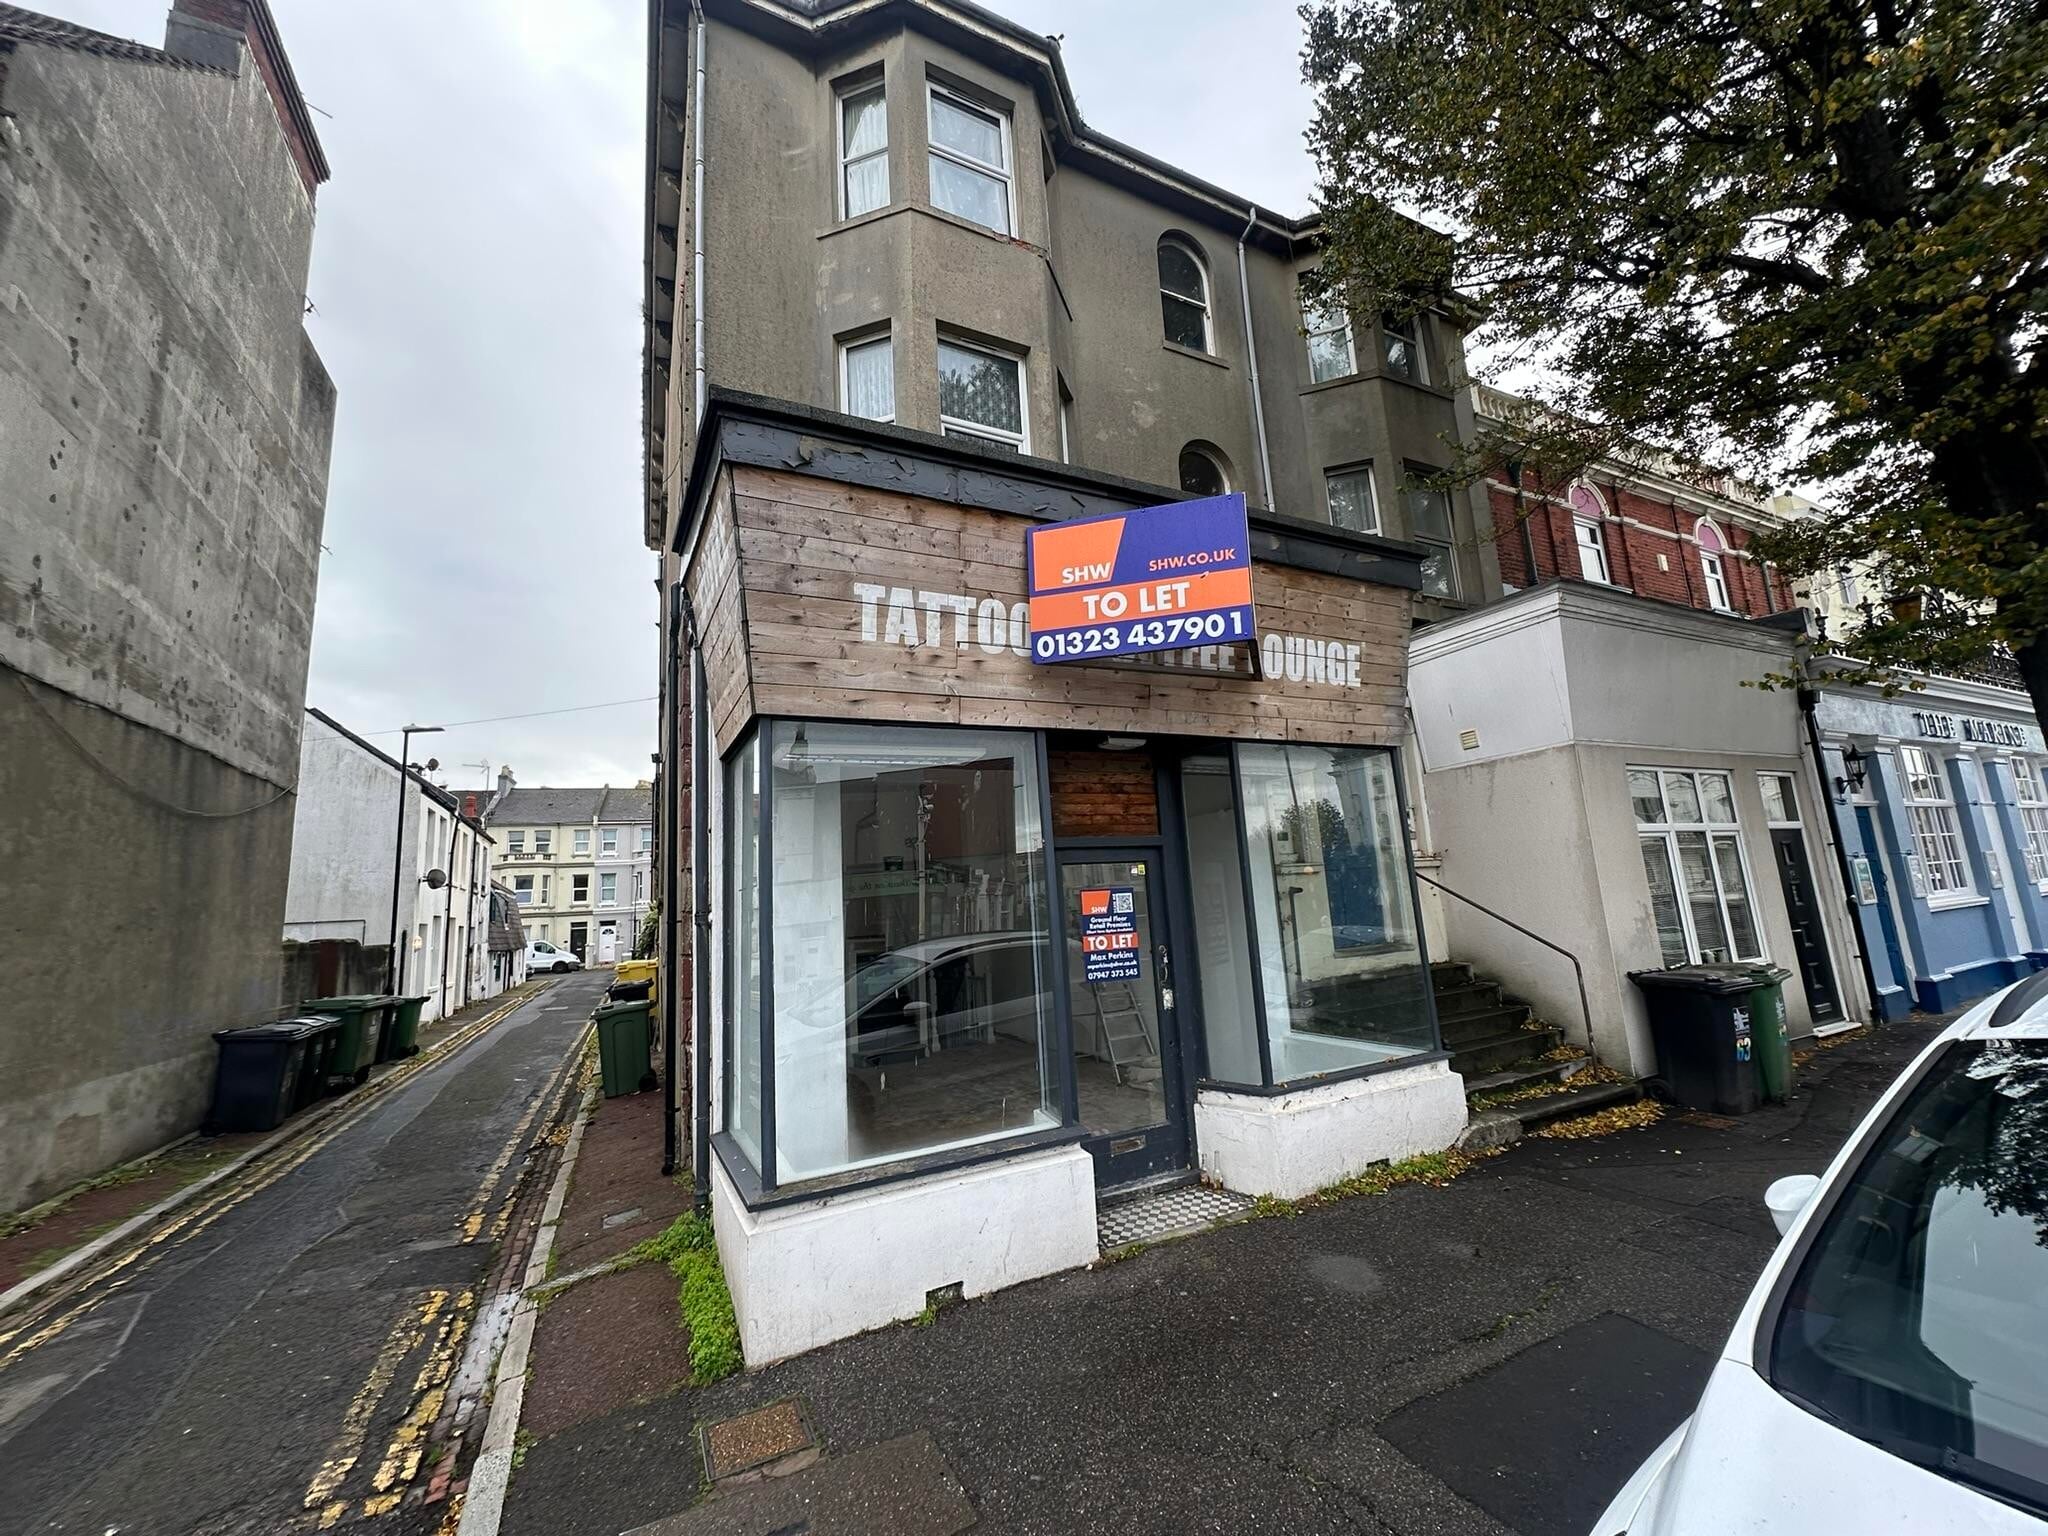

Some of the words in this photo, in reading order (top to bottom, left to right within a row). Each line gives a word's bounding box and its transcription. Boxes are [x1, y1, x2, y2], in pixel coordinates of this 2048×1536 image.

[1149, 548, 1236, 572] SHW.CO.UK
[1062, 562, 1111, 584] SHW
[1083, 591, 1129, 620] TO
[1139, 581, 1190, 614] LET
[1036, 627, 1121, 658] 01323
[1127, 611, 1242, 647] 437901
[1246, 633, 1361, 688] OUNGE
[1913, 712, 1958, 739] THE
[1090, 916, 1112, 924] Ground
[1091, 905, 1108, 913] SHW
[1088, 936, 1108, 951] TO
[1112, 934, 1133, 949] LET
[1090, 953, 1107, 961] Max
[1108, 951, 1134, 960] Perkins
[1088, 970, 1110, 980] 07947
[1110, 968, 1123, 978] 373
[1124, 966, 1138, 975] 545
[1736, 1037, 1751, 1061] 63
